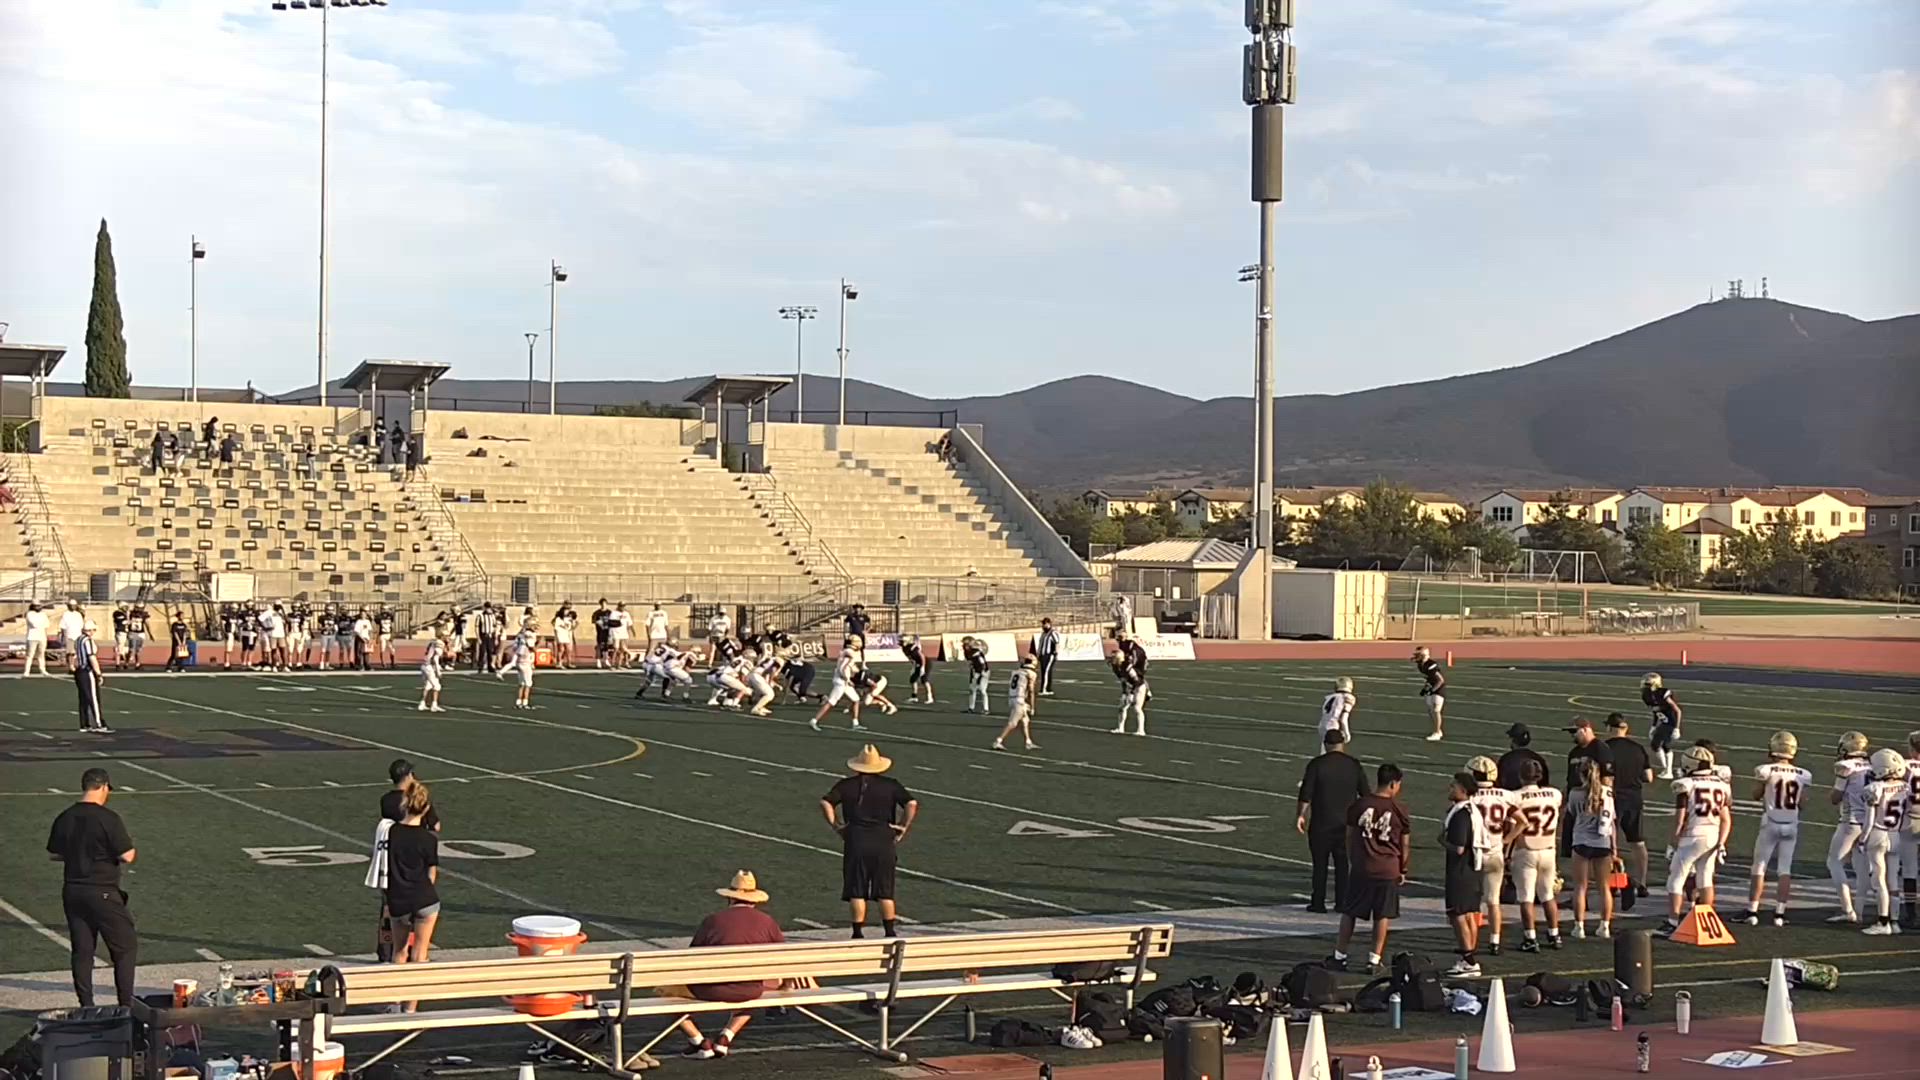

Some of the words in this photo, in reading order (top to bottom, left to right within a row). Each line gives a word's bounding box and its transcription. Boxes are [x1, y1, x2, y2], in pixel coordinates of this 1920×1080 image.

[1694, 787, 1724, 817] 59
[1774, 778, 1800, 811] 18
[1358, 807, 1393, 842] 44
[1522, 805, 1556, 837] 52
[1883, 799, 1901, 828] 5
[1697, 911, 1723, 939] 40
